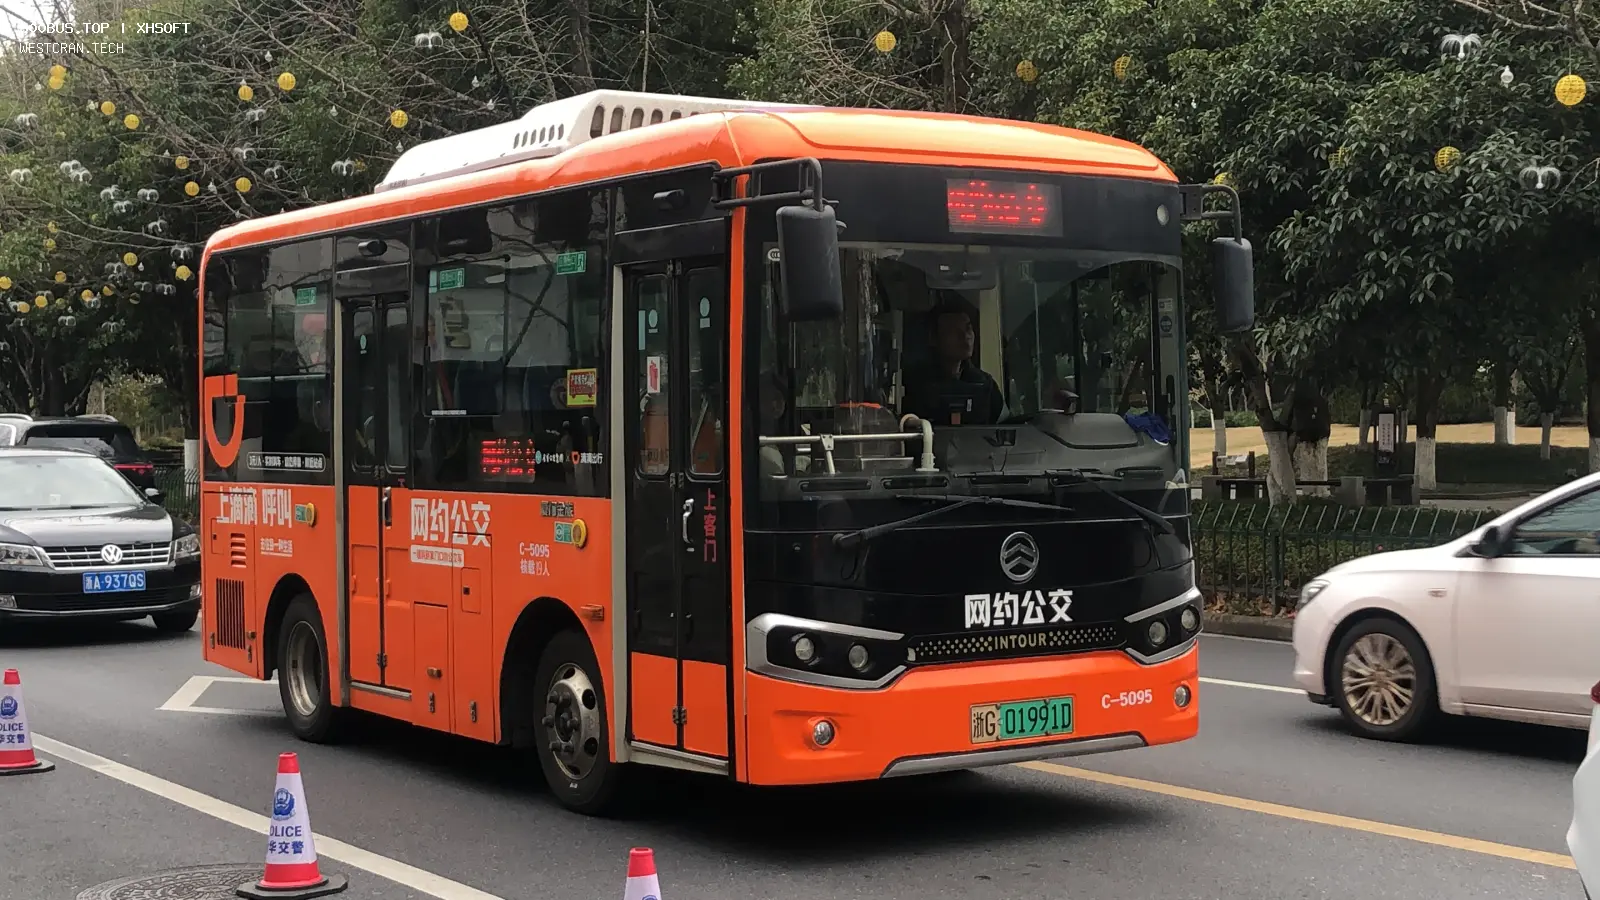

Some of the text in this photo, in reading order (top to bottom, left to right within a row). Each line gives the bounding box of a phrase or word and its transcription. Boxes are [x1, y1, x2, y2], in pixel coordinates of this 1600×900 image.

[217, 486, 293, 529] 上滴滴 呼叫
[411, 497, 491, 548] 网约公交
[703, 488, 717, 563] 上客门
[519, 542, 550, 558] C-5095
[964, 588, 1074, 629] 网约公交
[994, 632, 1048, 650] INTOUR
[1101, 688, 1153, 709] C-5095
